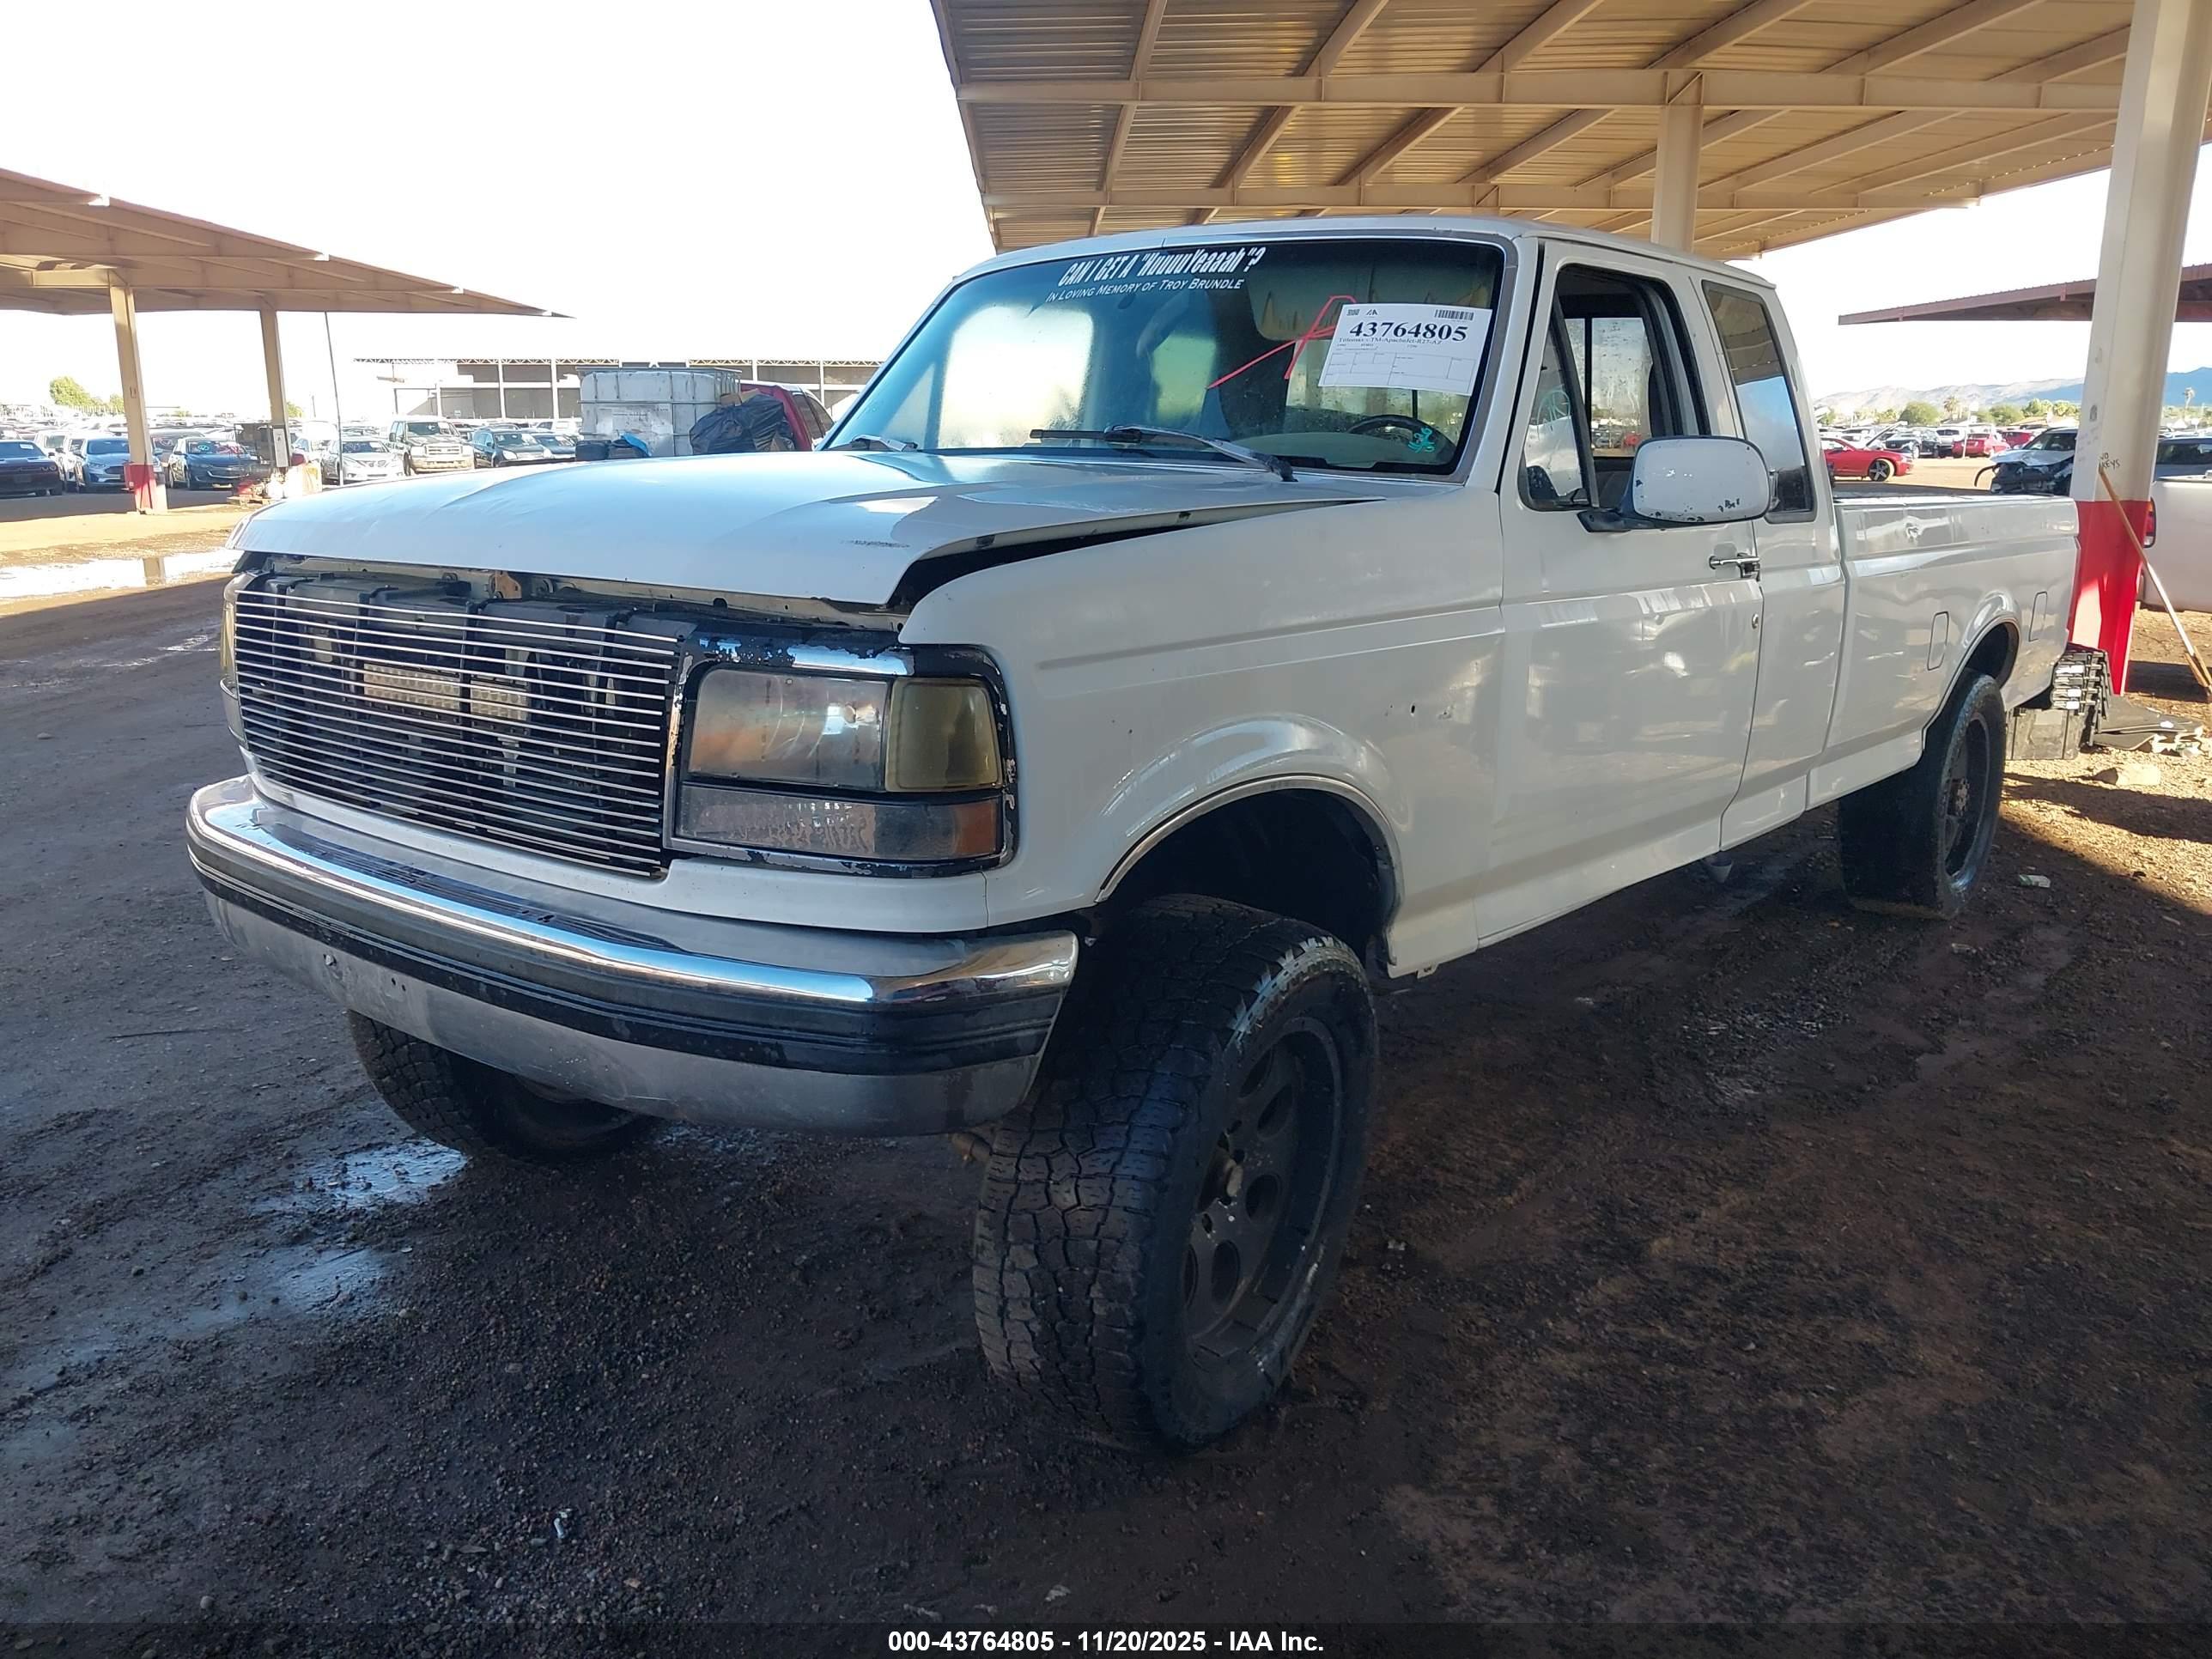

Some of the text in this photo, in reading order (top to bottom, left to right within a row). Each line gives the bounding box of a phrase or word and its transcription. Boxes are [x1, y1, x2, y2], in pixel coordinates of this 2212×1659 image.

[1058, 260, 1095, 287] CAN
[1084, 258, 1103, 283] I
[1093, 255, 1130, 282] GET
[1117, 254, 1140, 278] A
[1349, 321, 1468, 342] 43764805
